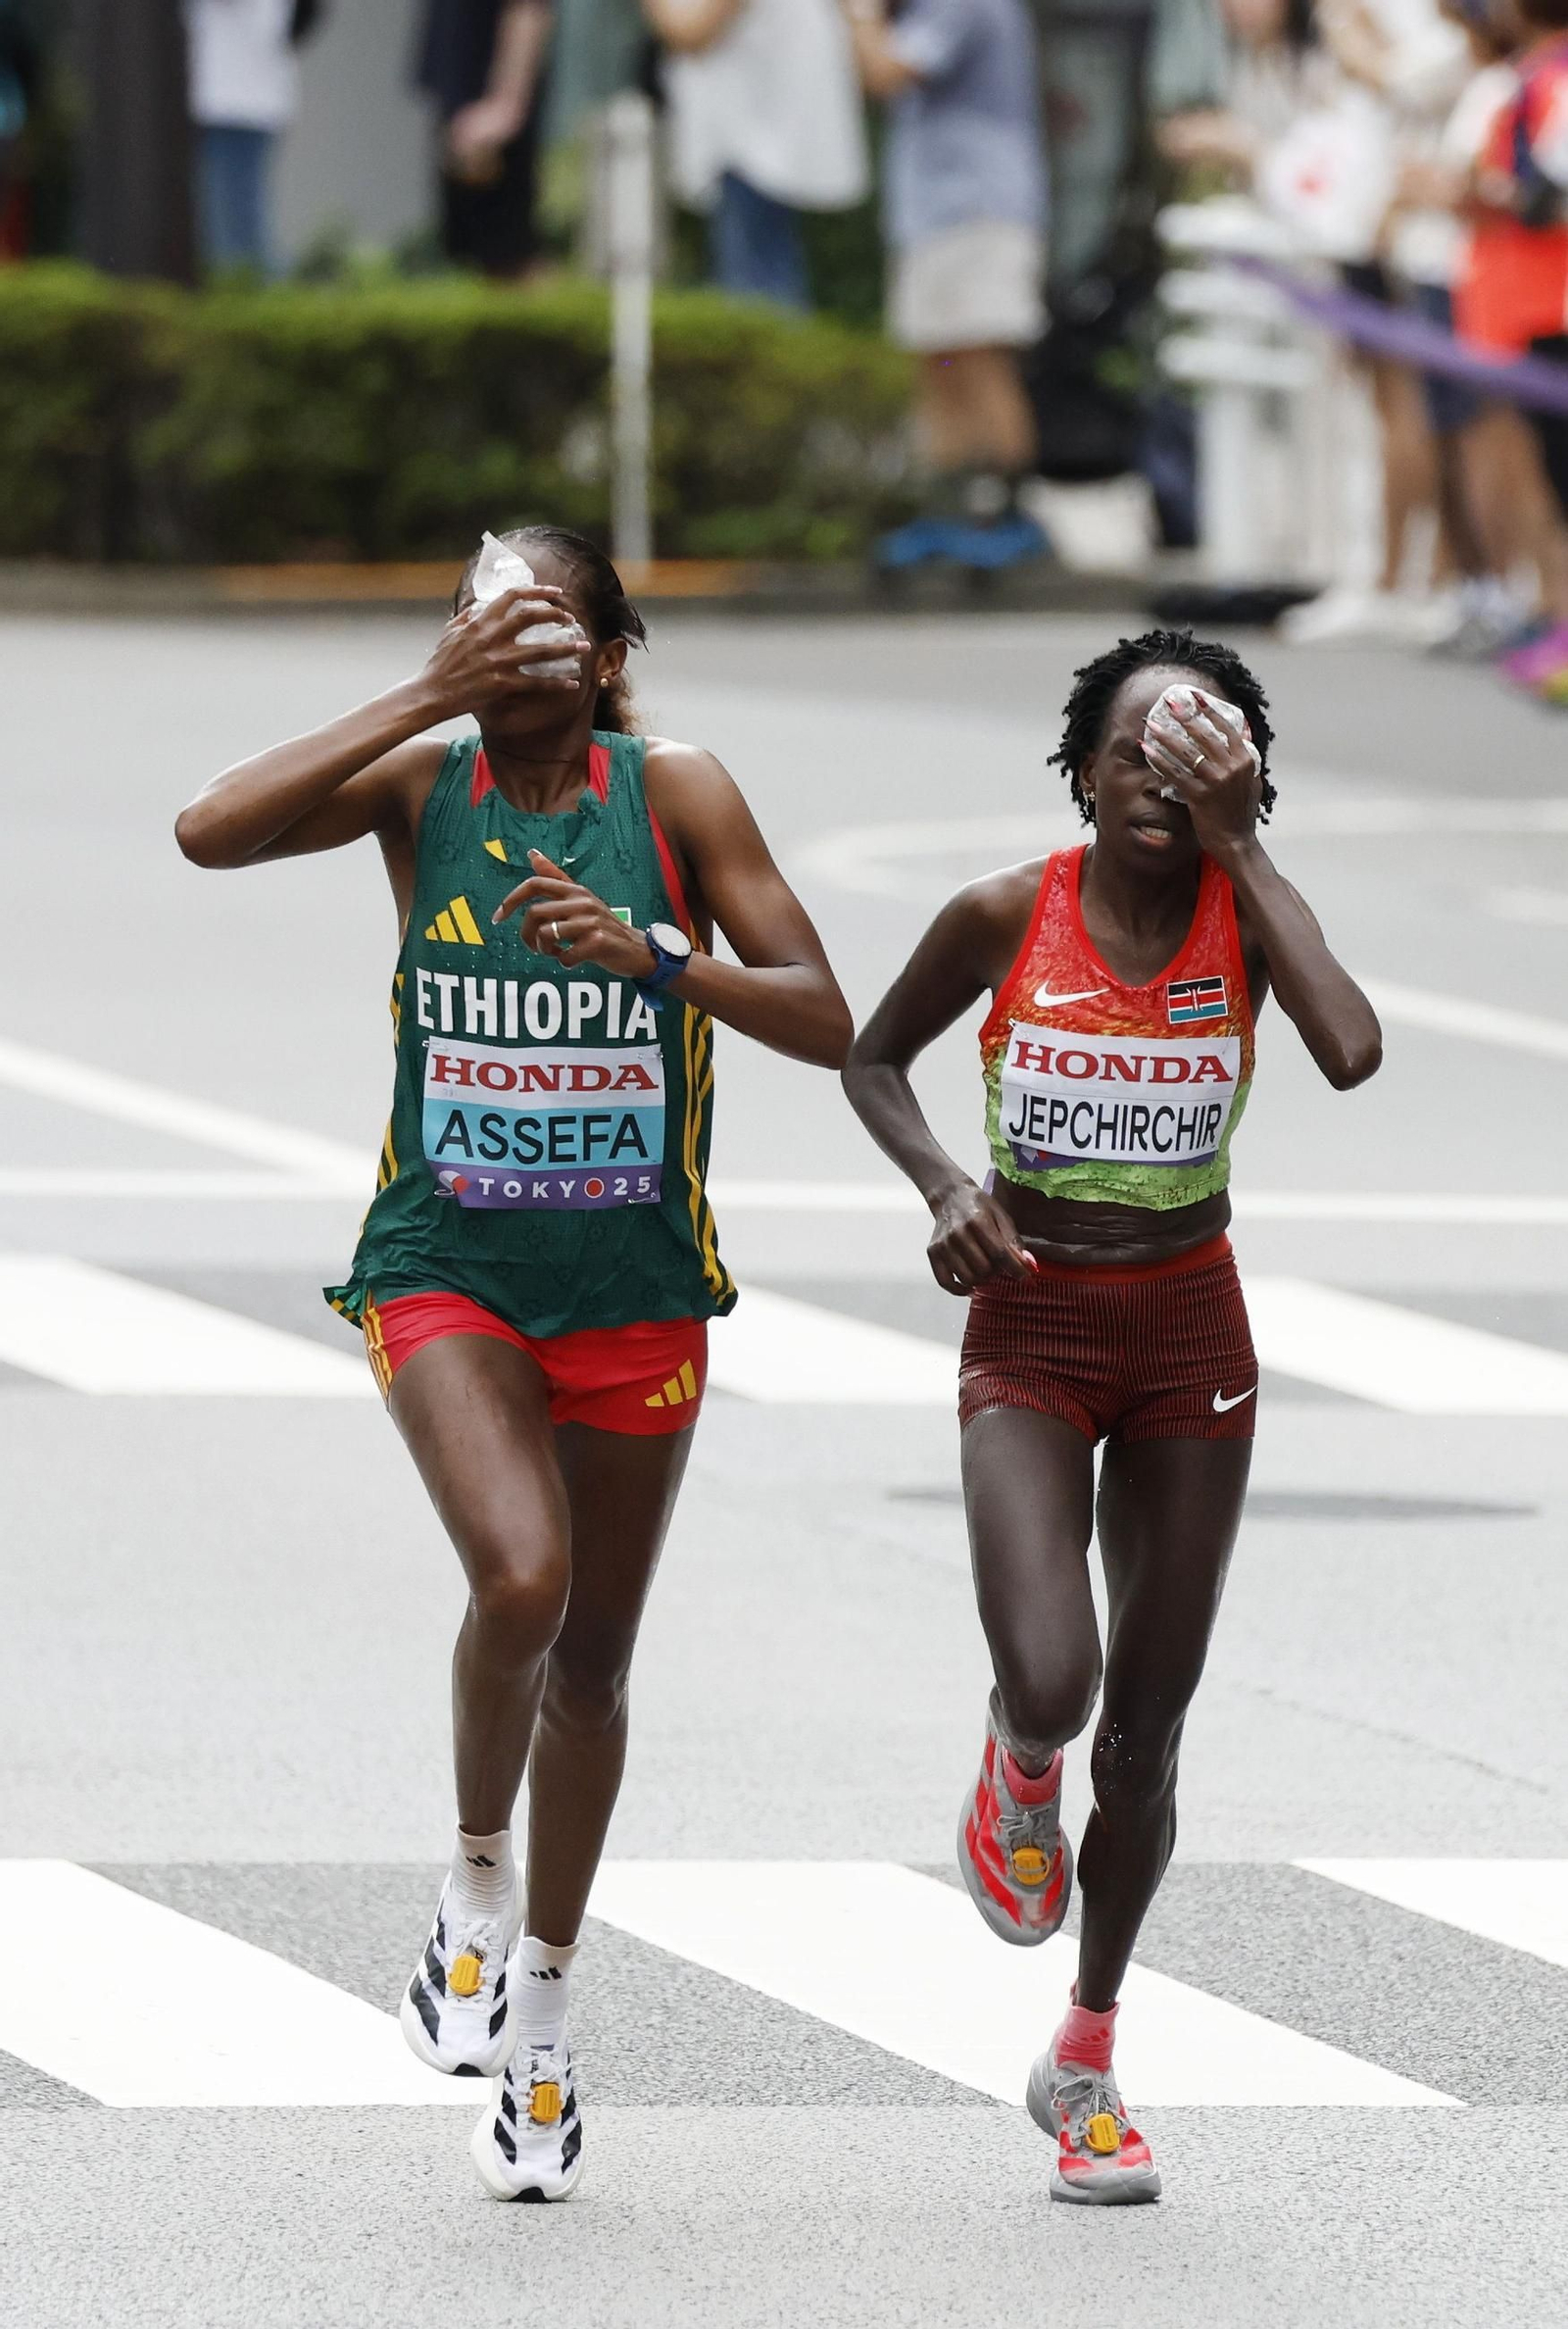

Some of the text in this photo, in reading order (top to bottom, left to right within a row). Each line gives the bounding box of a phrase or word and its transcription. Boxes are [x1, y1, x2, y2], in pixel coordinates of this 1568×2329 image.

[416, 966, 658, 1040] ETHIOPIA
[429, 1054, 660, 1093] HONDA
[1010, 1039, 1233, 1084] HONDA
[434, 1109, 649, 1165] ASSEFA
[1008, 1093, 1222, 1154] JEPCHIRCHIR
[478, 1176, 651, 1200] TOKYO 25
